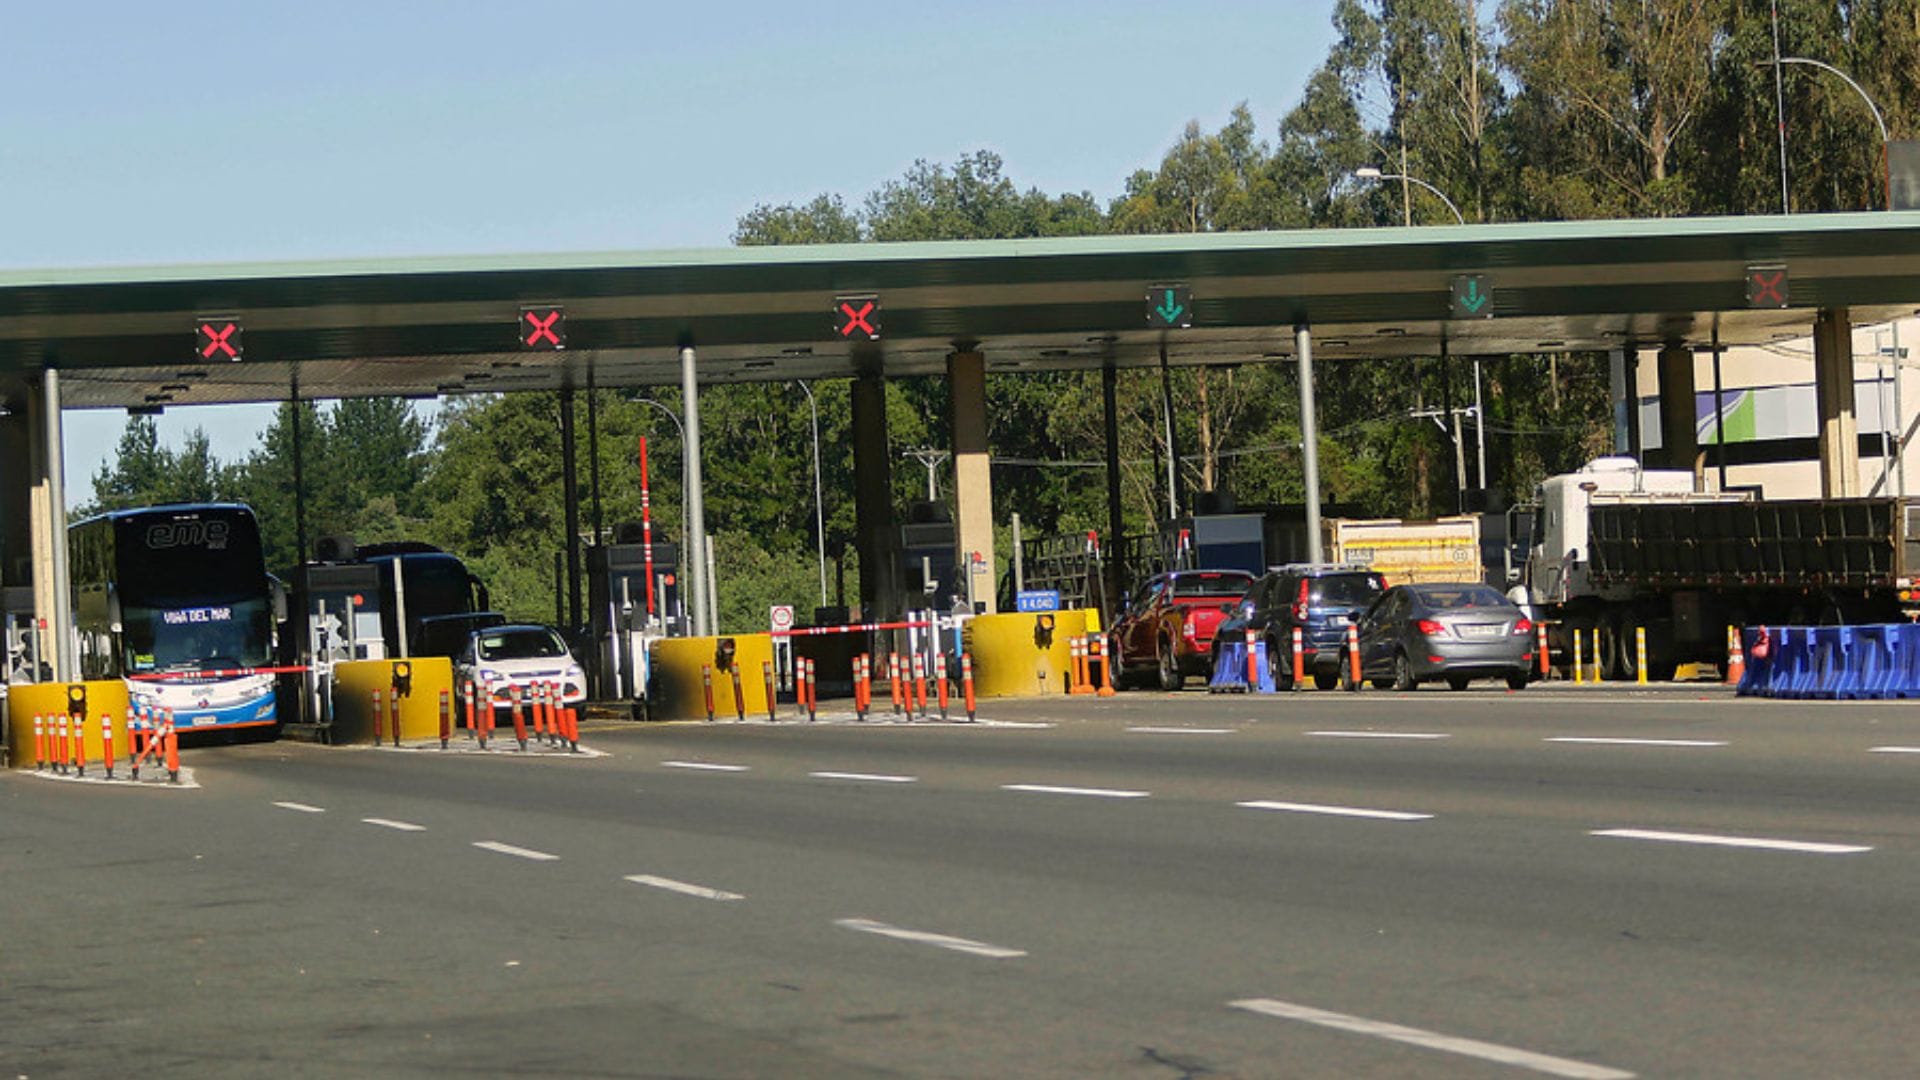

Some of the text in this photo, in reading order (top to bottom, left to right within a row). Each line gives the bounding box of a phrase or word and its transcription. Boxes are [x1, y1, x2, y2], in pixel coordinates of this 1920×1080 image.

[146, 521, 229, 549] eme
[189, 610, 209, 622] DEL
[210, 607, 231, 620] MAR
